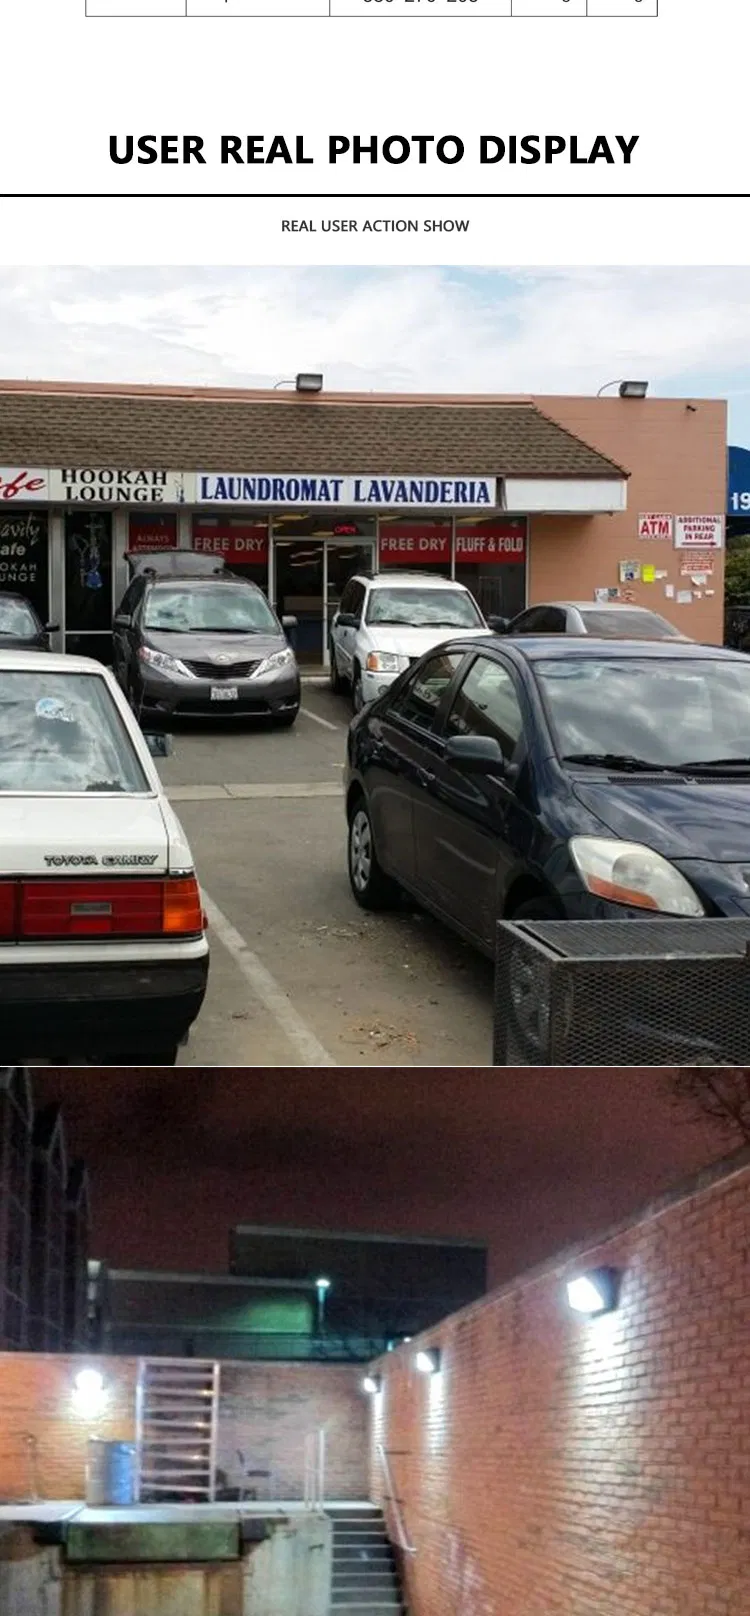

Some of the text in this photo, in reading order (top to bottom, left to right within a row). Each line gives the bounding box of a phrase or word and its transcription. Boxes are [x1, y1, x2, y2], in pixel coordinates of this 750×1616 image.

[0, 471, 46, 499] fe
[61, 469, 167, 486] HOOKAH
[66, 486, 164, 502] LOUNGE
[201, 476, 491, 504] LAUNDROMAT LAVANDERIA
[334, 525, 356, 534] OPEN
[641, 520, 669, 535] ATM
[194, 537, 265, 551] FREE DRY
[381, 538, 447, 551] FREE DRY
[456, 537, 524, 552] FLUFF & FOLD
[44, 855, 159, 866] TOYOTA CAMRY
